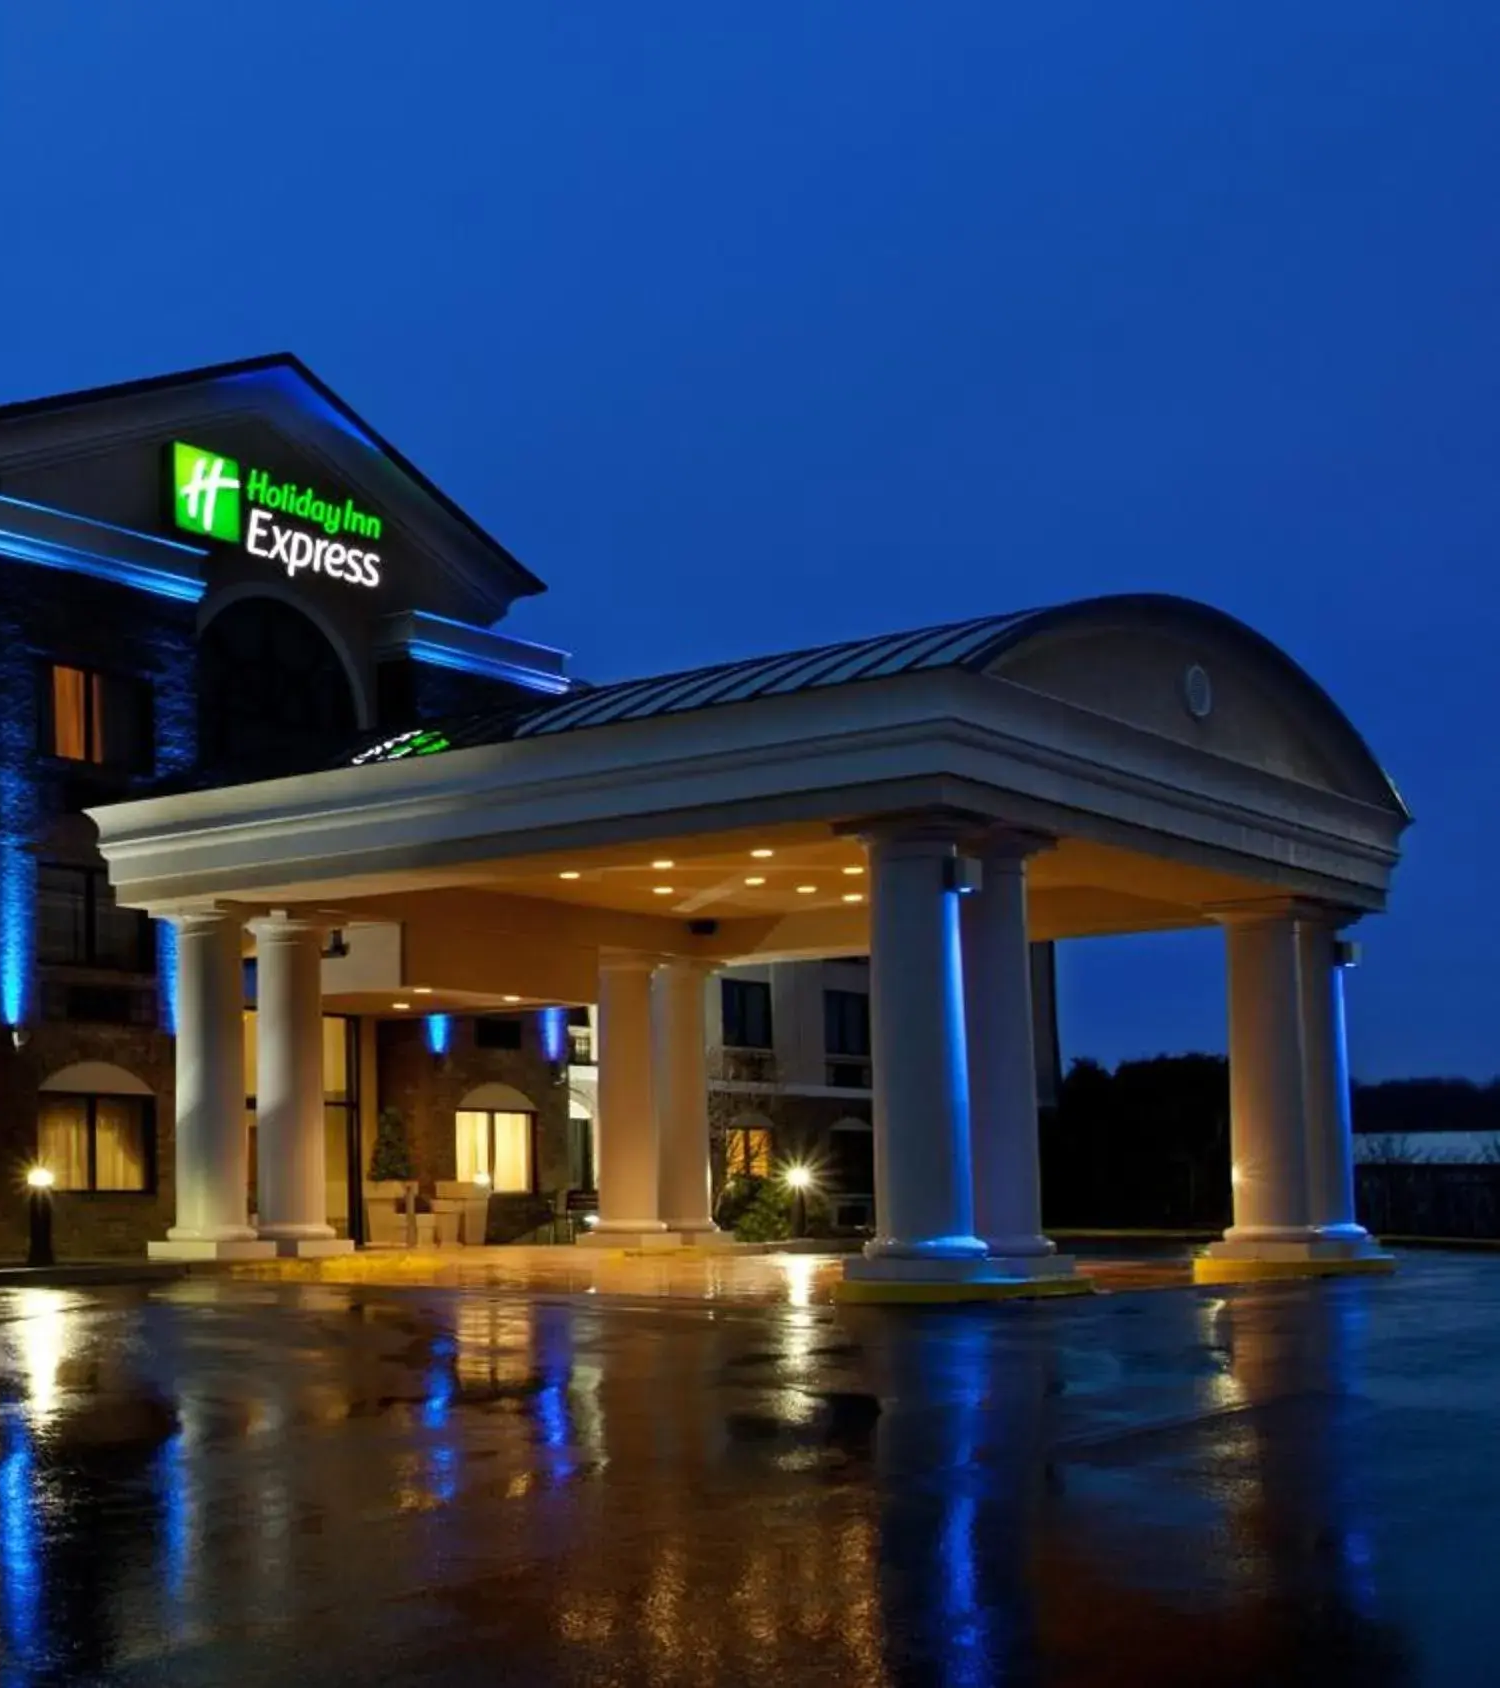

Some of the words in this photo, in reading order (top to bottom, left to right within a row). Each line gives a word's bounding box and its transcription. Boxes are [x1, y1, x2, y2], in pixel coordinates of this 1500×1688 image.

[247, 468, 342, 534] Holiday
[343, 499, 381, 539] Inn
[246, 508, 381, 587] Express
